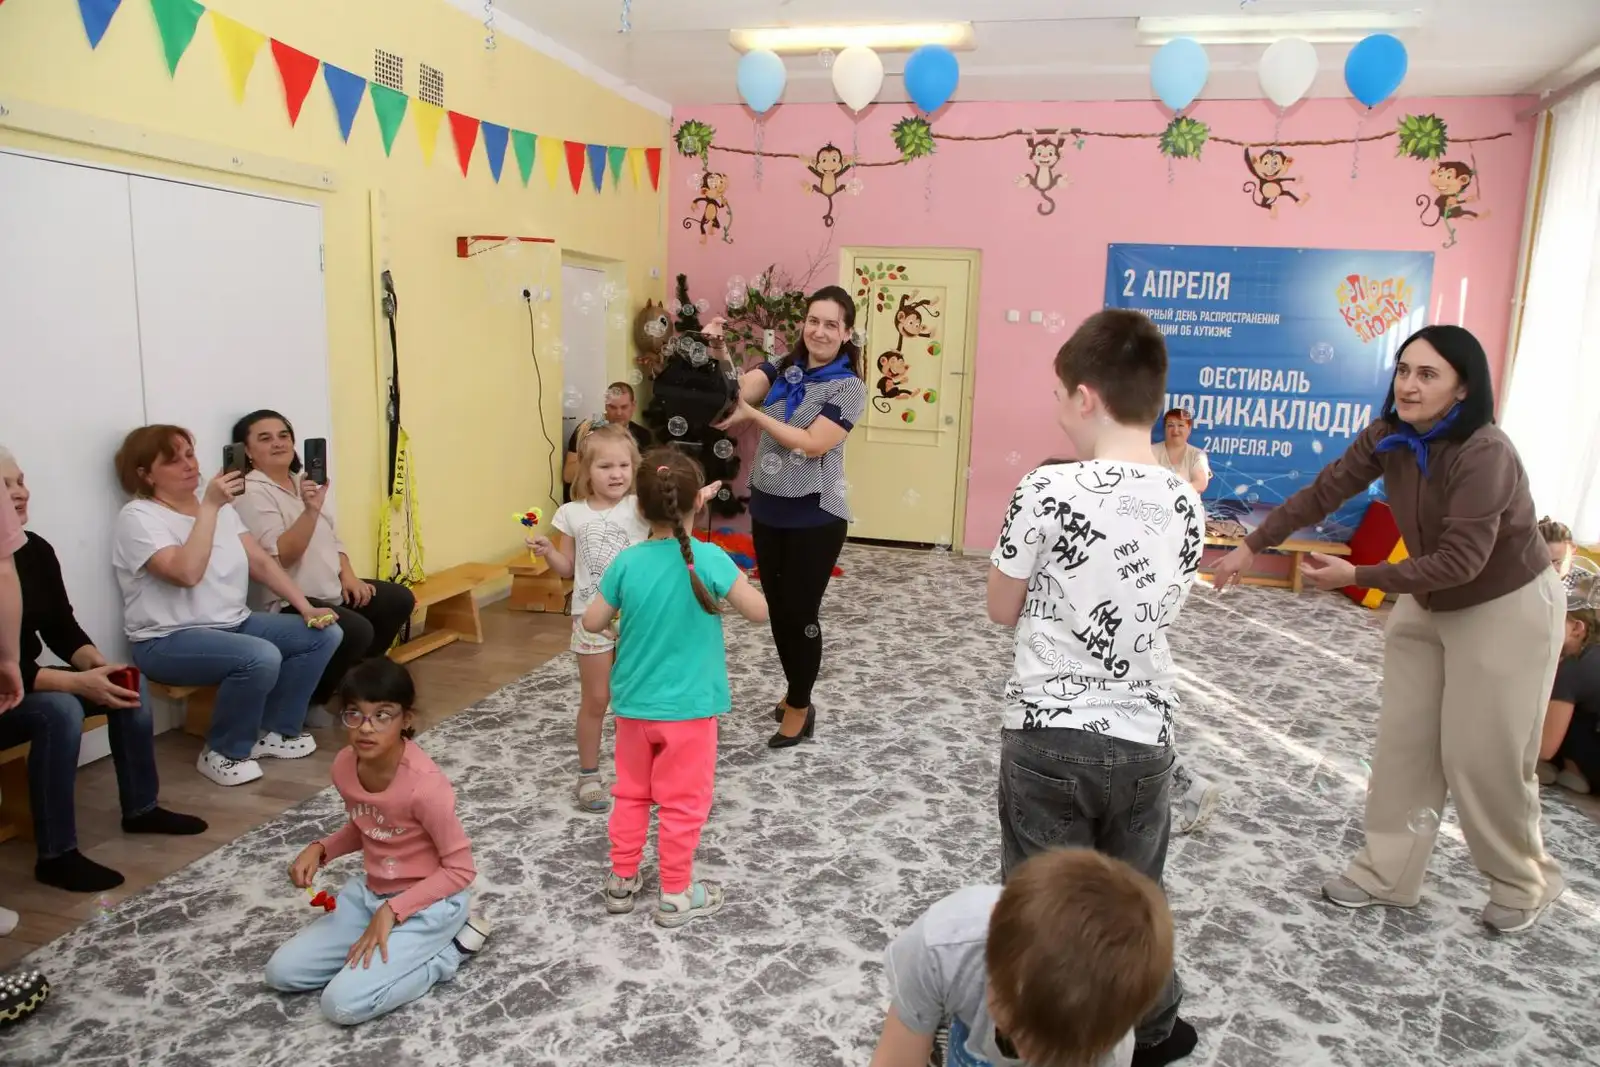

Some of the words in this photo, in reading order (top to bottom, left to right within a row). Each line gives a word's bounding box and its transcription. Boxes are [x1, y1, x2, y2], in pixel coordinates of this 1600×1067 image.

[1122, 269, 1136, 297] 2
[1142, 269, 1231, 301] АПРЕЛЯ
[1174, 309, 1198, 322] ДЕНЬ
[1200, 310, 1281, 325] РАСПРОСТРАНЕНИЯ
[1180, 325, 1192, 336] ОБ
[1193, 326, 1233, 338] АУТИЗМЕ
[1199, 366, 1311, 393] ФЕСТИВАЛЬ
[1203, 436, 1293, 458] 2АПРЕЛЯ.РФ
[395, 449, 405, 495] KIPSTA
[1052, 535, 1090, 571] DAY
[1113, 539, 1140, 561] FUN
[1117, 557, 1151, 580] HAVE
[1136, 573, 1157, 589] AND
[1020, 599, 1064, 621] HILL
